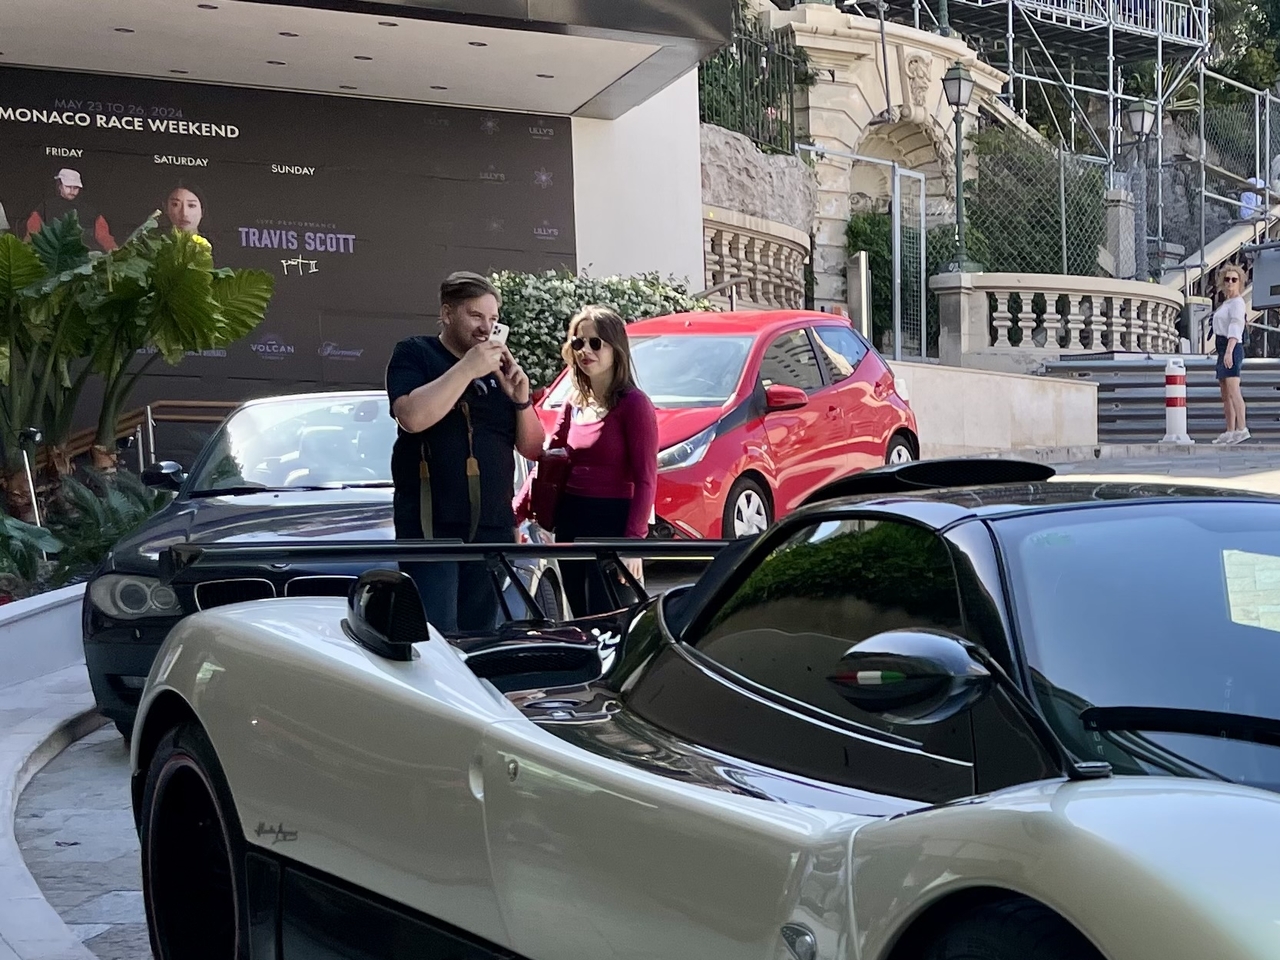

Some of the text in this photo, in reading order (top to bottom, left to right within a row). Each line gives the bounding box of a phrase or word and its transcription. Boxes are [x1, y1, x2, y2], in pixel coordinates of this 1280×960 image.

[54, 98, 83, 110] MAY
[87, 101, 103, 112] 23
[107, 103, 125, 113] TO
[151, 106, 183, 118] 2024
[0, 106, 240, 138] MONACO RACE WEEKEND
[46, 146, 84, 158] FRIDAY
[154, 154, 209, 167] SATURDAY
[271, 163, 316, 176] SUNDAY
[238, 227, 356, 253] TRAVIS SCOTT
